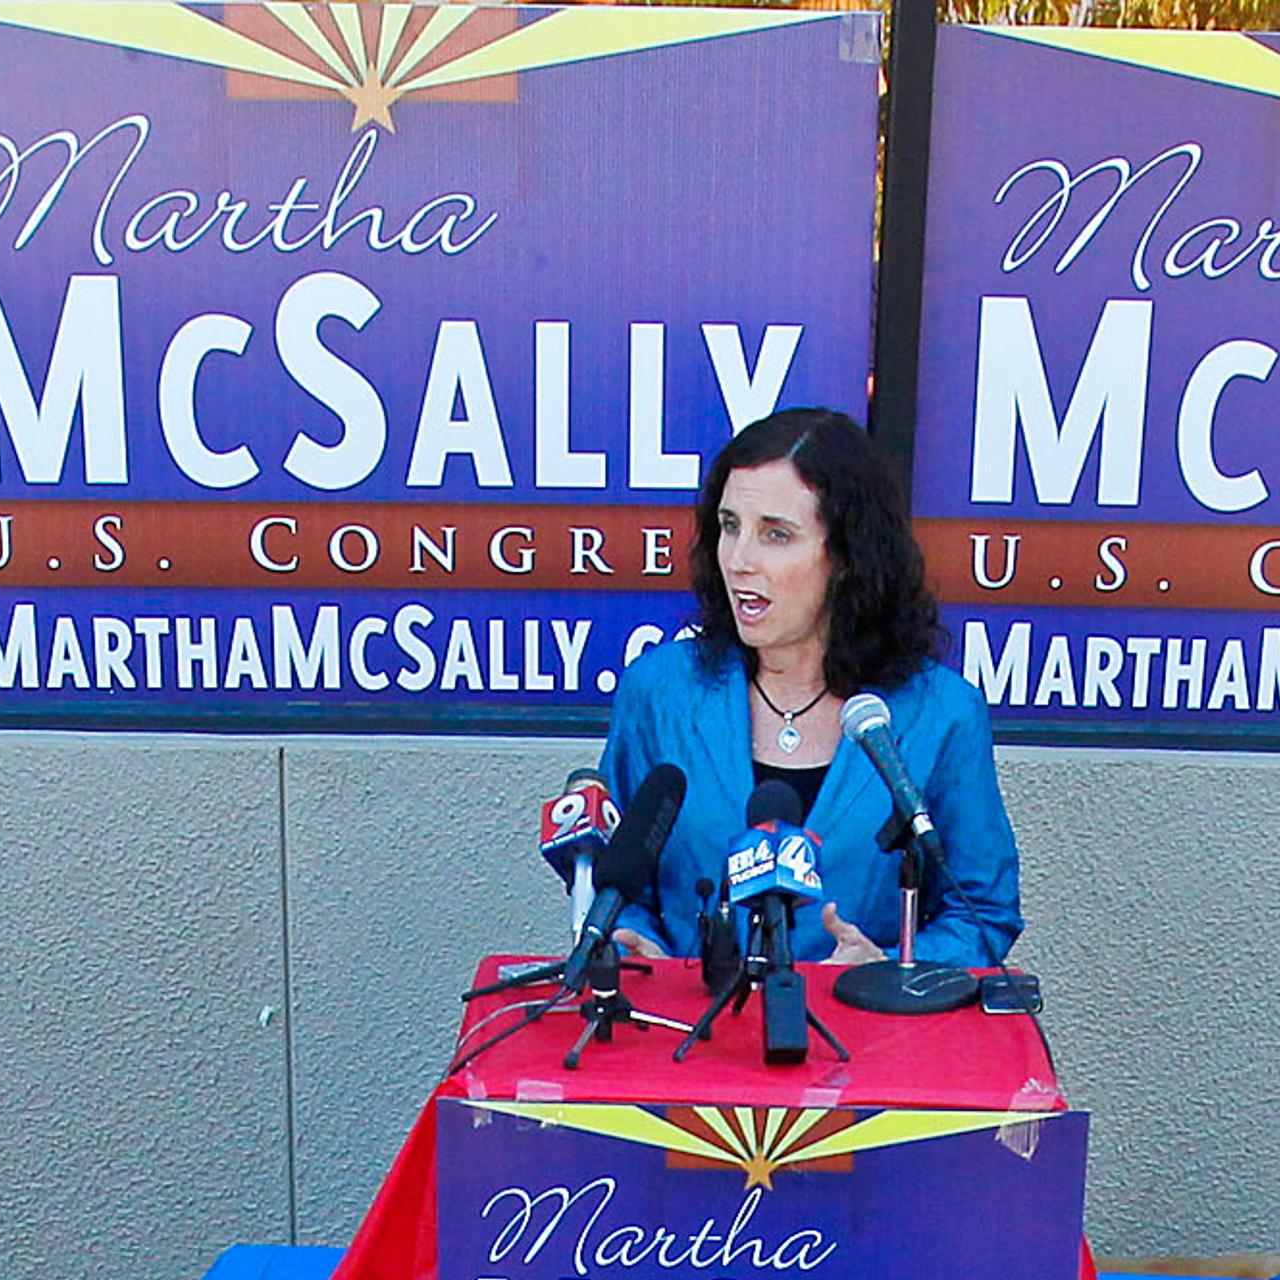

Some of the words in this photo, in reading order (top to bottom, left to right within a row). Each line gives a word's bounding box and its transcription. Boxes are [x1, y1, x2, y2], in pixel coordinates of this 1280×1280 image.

[249, 516, 673, 575] CONGRE
[968, 533, 1172, 592] U.S.
[481, 1177, 838, 1276] Martha
